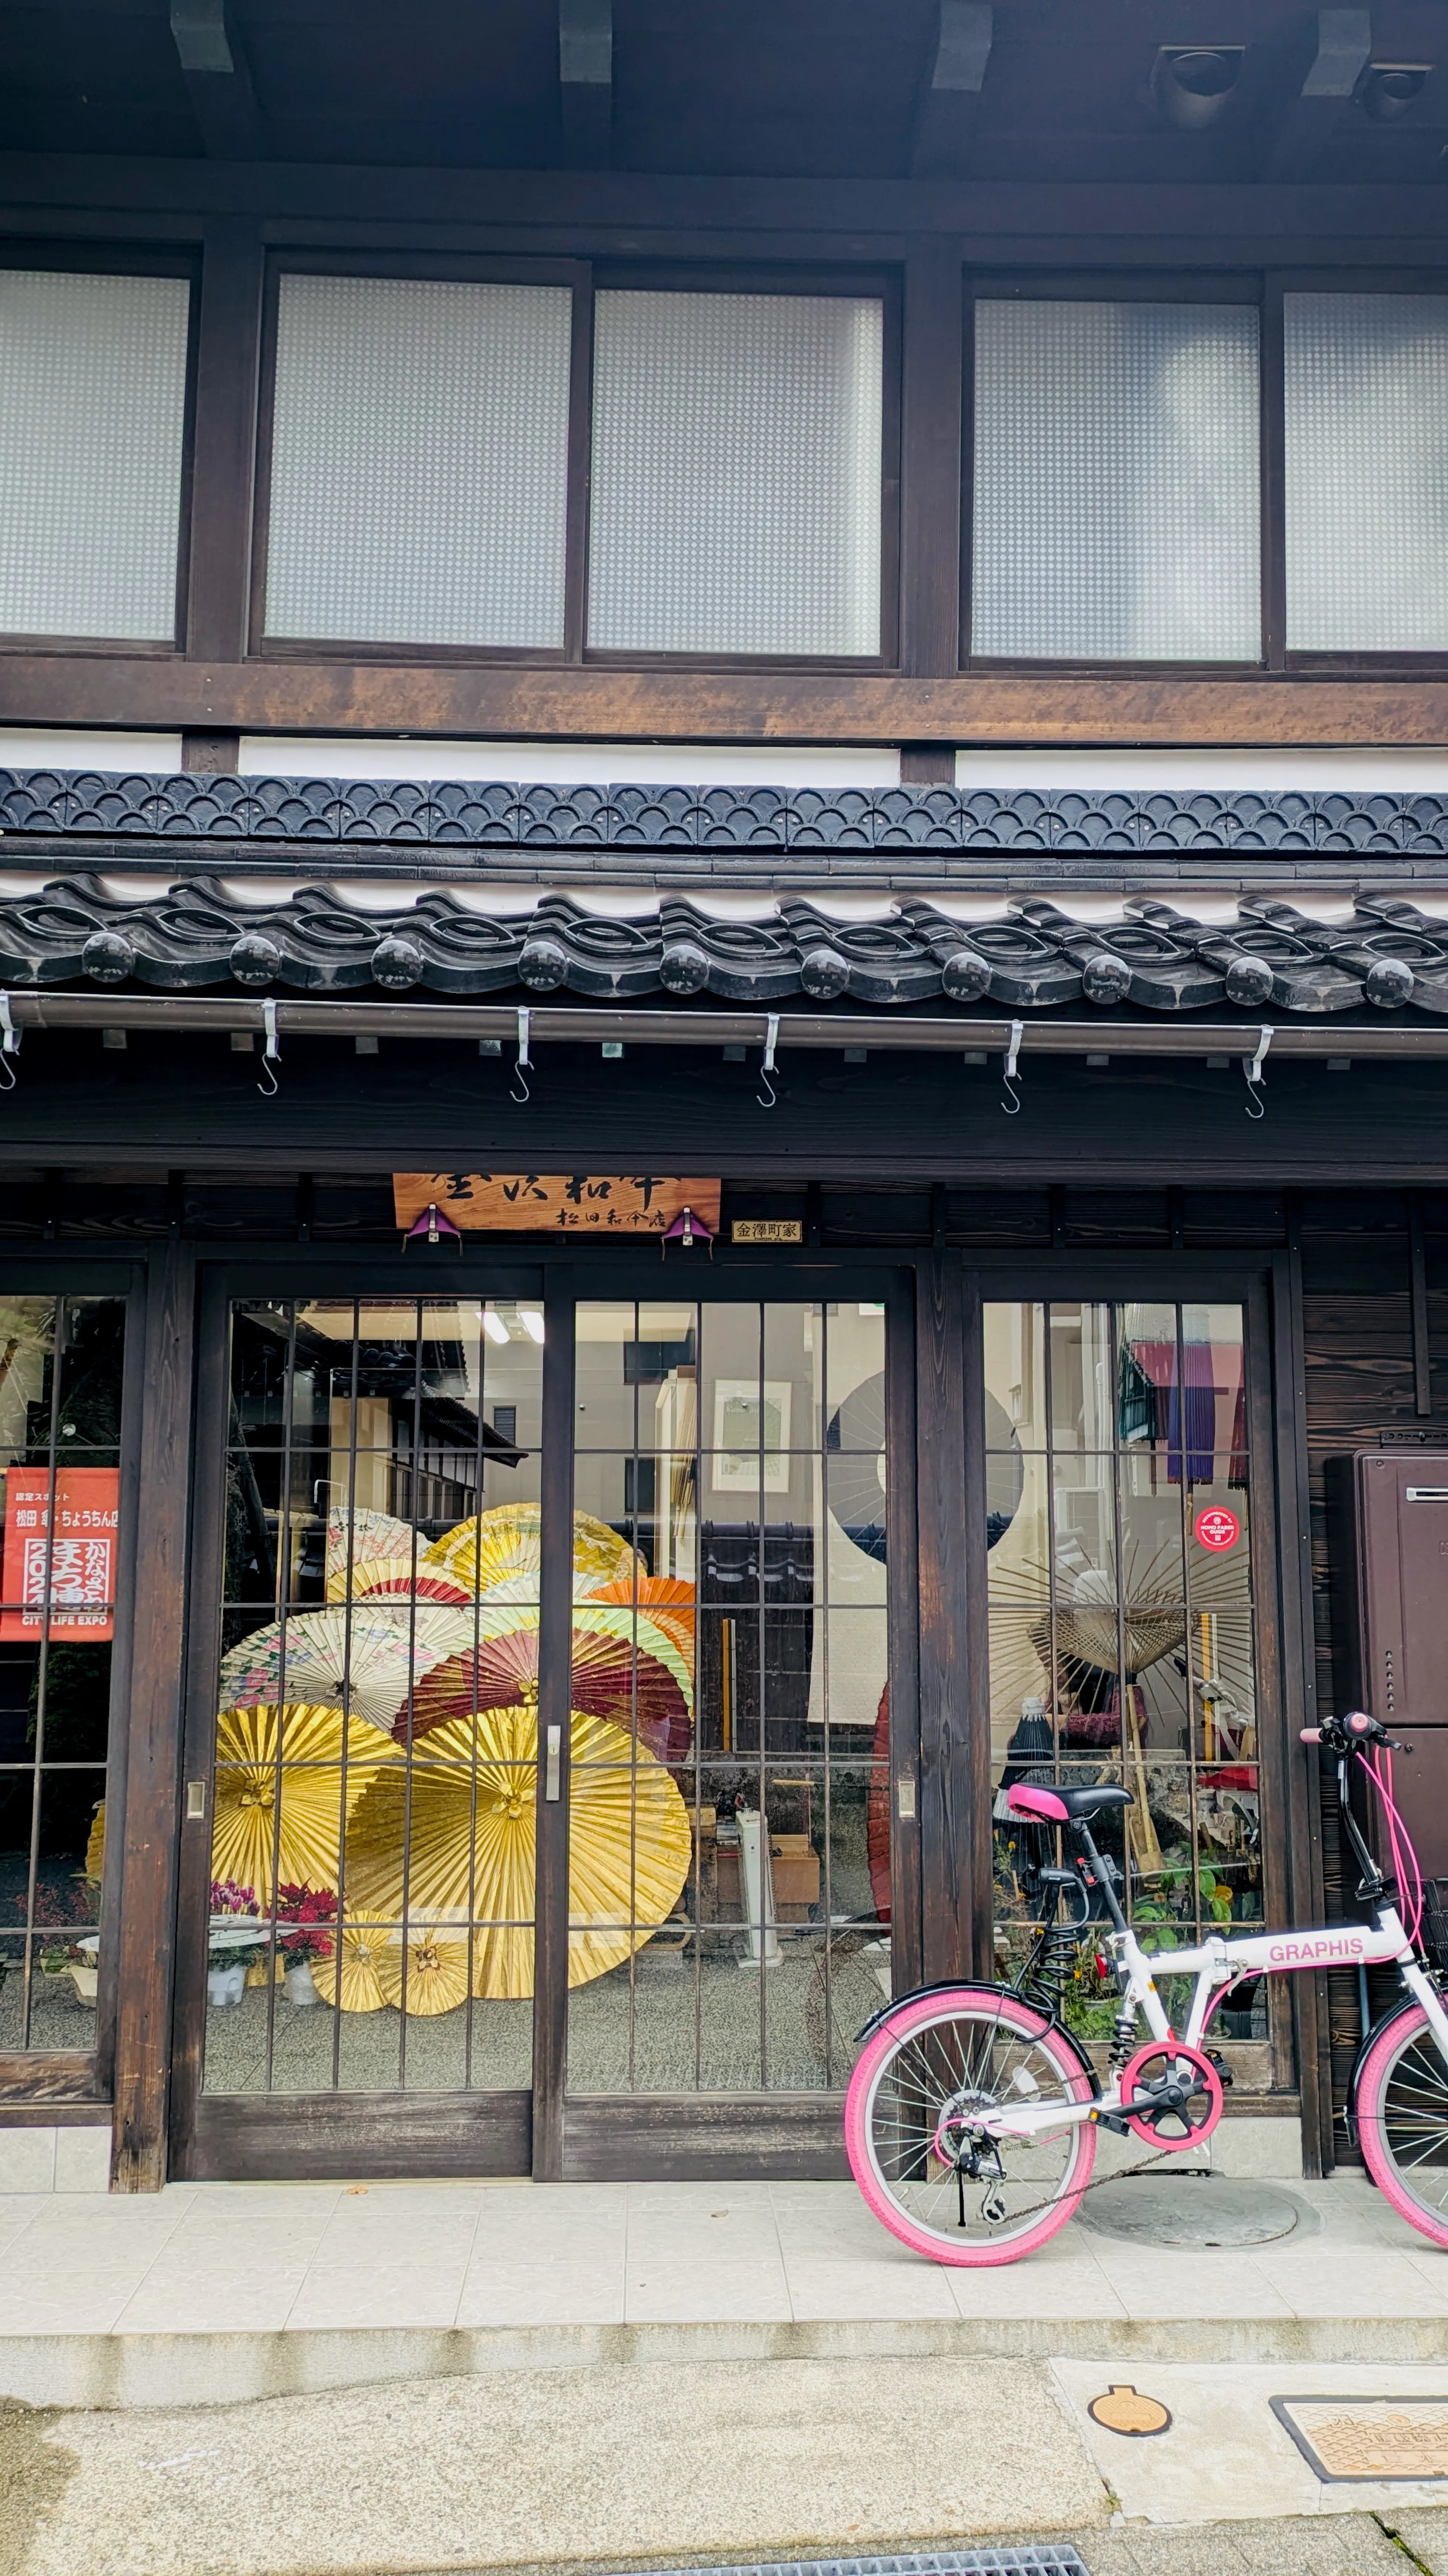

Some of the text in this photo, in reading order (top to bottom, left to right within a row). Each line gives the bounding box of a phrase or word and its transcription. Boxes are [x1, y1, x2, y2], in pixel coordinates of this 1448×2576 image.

[736, 1223, 796, 1237] 金澤町家
[22, 1616, 107, 1626] CIT LIFE EXPO
[1270, 1938, 1364, 1961] GRAPHIS
